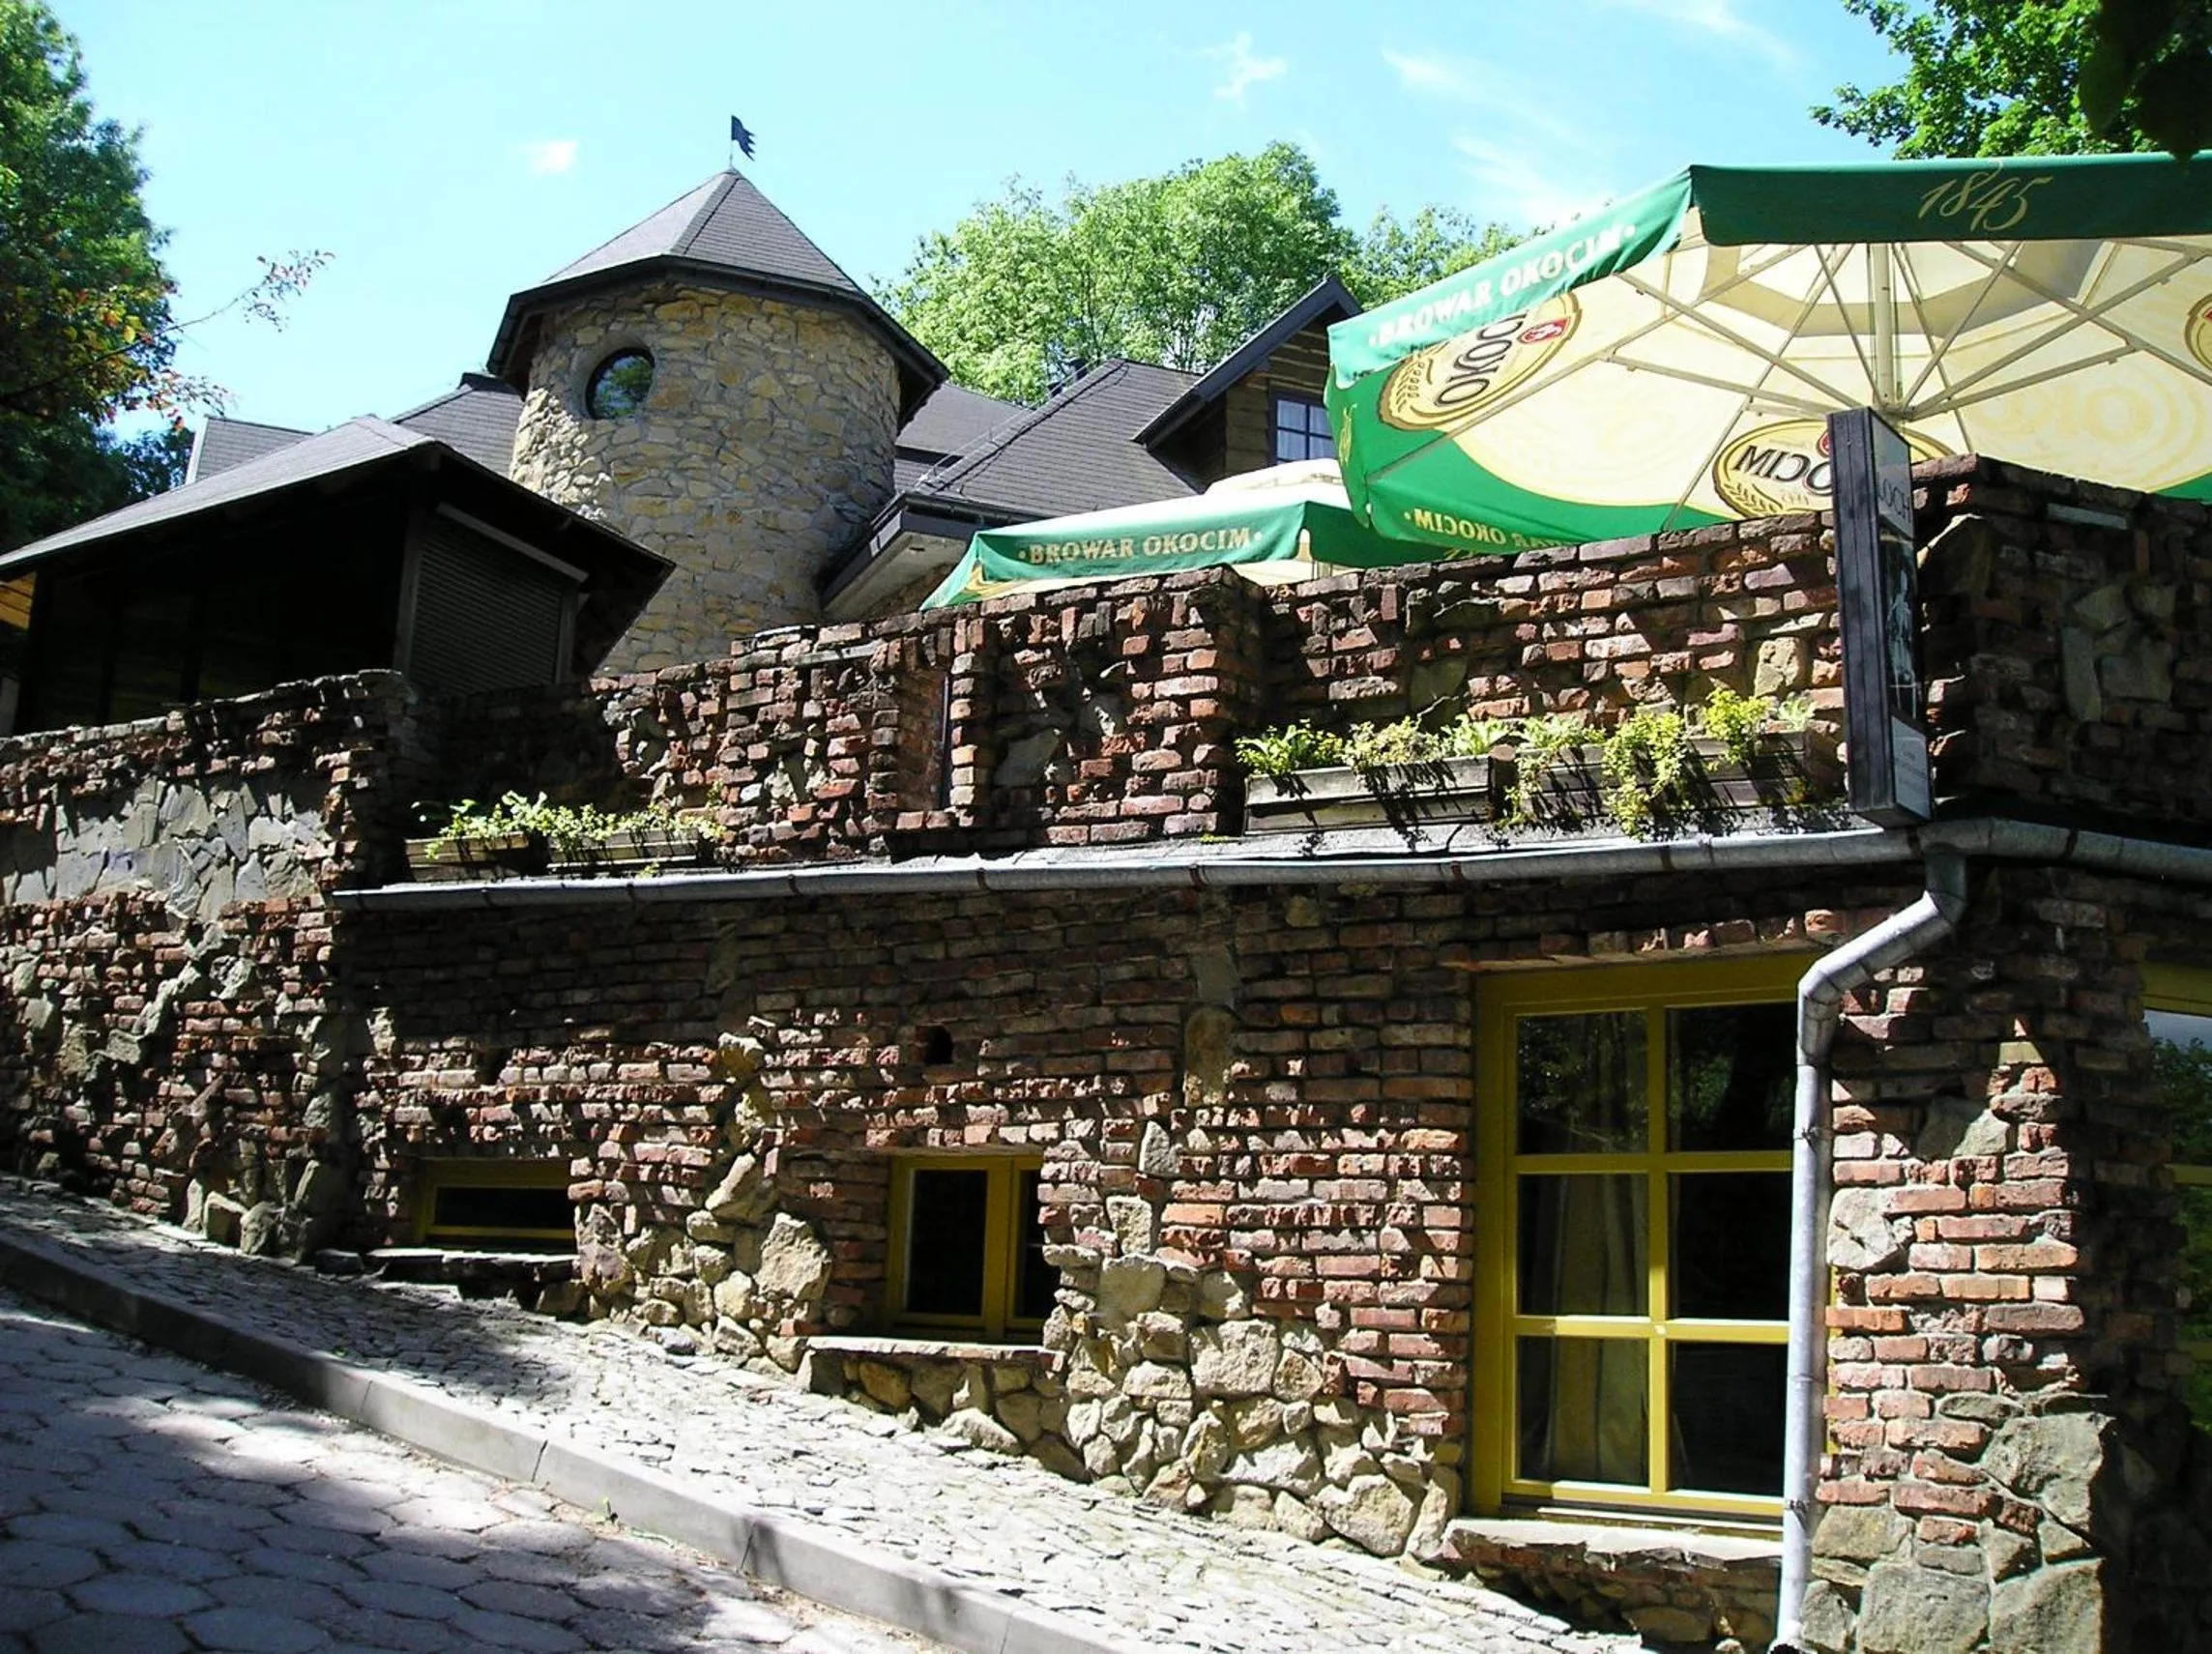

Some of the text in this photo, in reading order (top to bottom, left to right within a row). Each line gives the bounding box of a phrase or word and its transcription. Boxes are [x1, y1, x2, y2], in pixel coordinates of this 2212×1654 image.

[1918, 158, 2053, 232] 1845
[1379, 224, 1626, 345] BROWAR OKOCIM
[1435, 310, 1528, 407] OKOC
[1030, 528, 1251, 564] BROWAR OKOCIM
